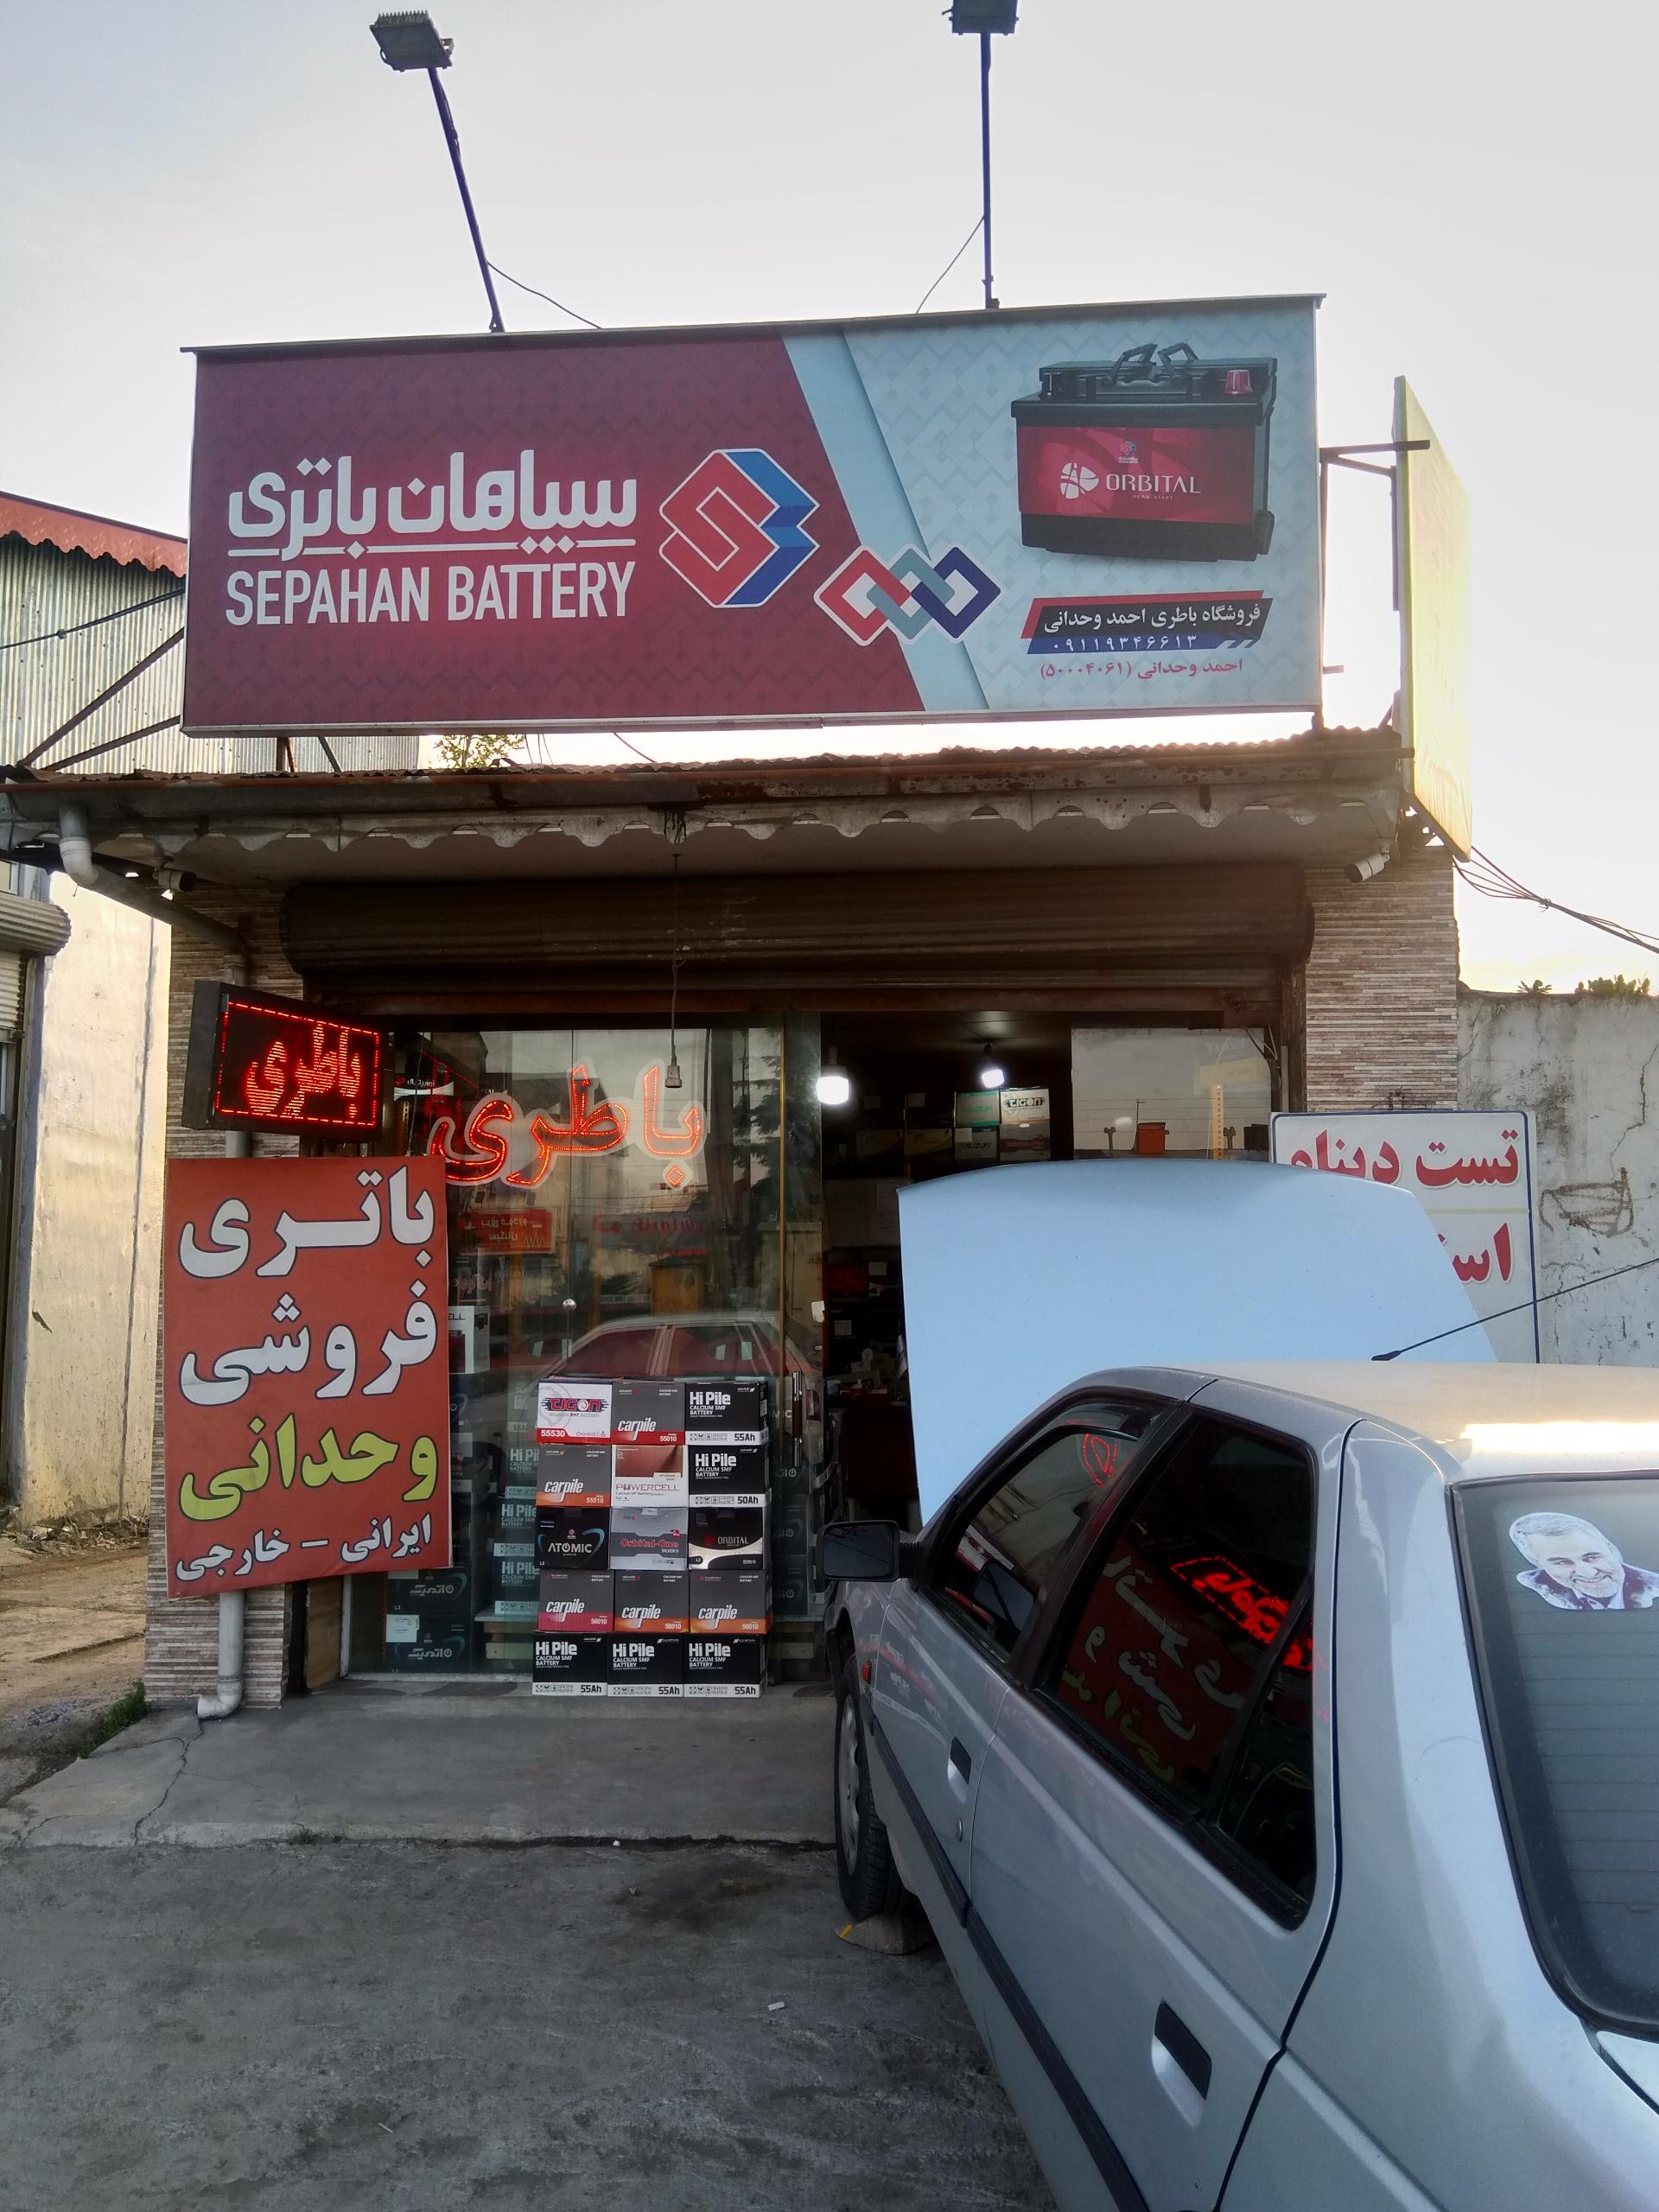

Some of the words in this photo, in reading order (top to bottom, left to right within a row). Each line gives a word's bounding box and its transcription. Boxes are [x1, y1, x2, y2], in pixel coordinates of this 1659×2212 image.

[1106, 474, 1202, 493] ORBITAL
[228, 456, 377, 561] باتری
[389, 449, 637, 554] سپاهان
[226, 566, 429, 625] SEPAHAN
[448, 561, 636, 620] BATTERY
[1044, 610, 1102, 632] وحدانی
[1106, 608, 1146, 625] احمد
[1151, 606, 1198, 629] باطری
[1202, 603, 1261, 626] فروشگاه
[1138, 661, 1198, 679] وحدانی
[1202, 658, 1243, 674] احمد
[245, 1020, 361, 1119] باطری
[430, 1063, 706, 1187] باطری
[1414, 1128, 1520, 1189] تست
[179, 1165, 435, 1279] باتری
[179, 1280, 439, 1405] فروشی
[690, 1392, 702, 1405] Hi
[705, 1392, 731, 1405] Pile
[540, 1429, 566, 1438] 55530
[618, 1417, 657, 1441] carpile
[734, 1433, 755, 1441] 55Ah
[510, 1448, 523, 1461] Hi
[525, 1448, 539, 1461] Pil
[695, 1453, 709, 1466] Hi
[711, 1453, 737, 1466] Pile
[178, 1414, 439, 1522] وحدانی
[544, 1478, 584, 1503] carpile
[737, 1496, 759, 1504] 50Ah
[501, 1504, 513, 1517] Hi
[516, 1504, 537, 1517] Pile
[340, 1513, 432, 1563] ایرانی
[548, 1543, 593, 1554] ATOMIC
[717, 1536, 749, 1545] ORBITAL
[175, 1527, 290, 1581] خارجی
[501, 1561, 513, 1574] Hi
[516, 1561, 539, 1574] Pile
[545, 1599, 585, 1623] carpile
[621, 1605, 661, 1629] carpile
[698, 1605, 738, 1630] carpile
[536, 1642, 550, 1656] Hi
[551, 1642, 577, 1656] Pile
[613, 1643, 626, 1657] Hi
[629, 1643, 655, 1657] Pile
[689, 1643, 702, 1657] Hi
[705, 1643, 731, 1657] Pile
